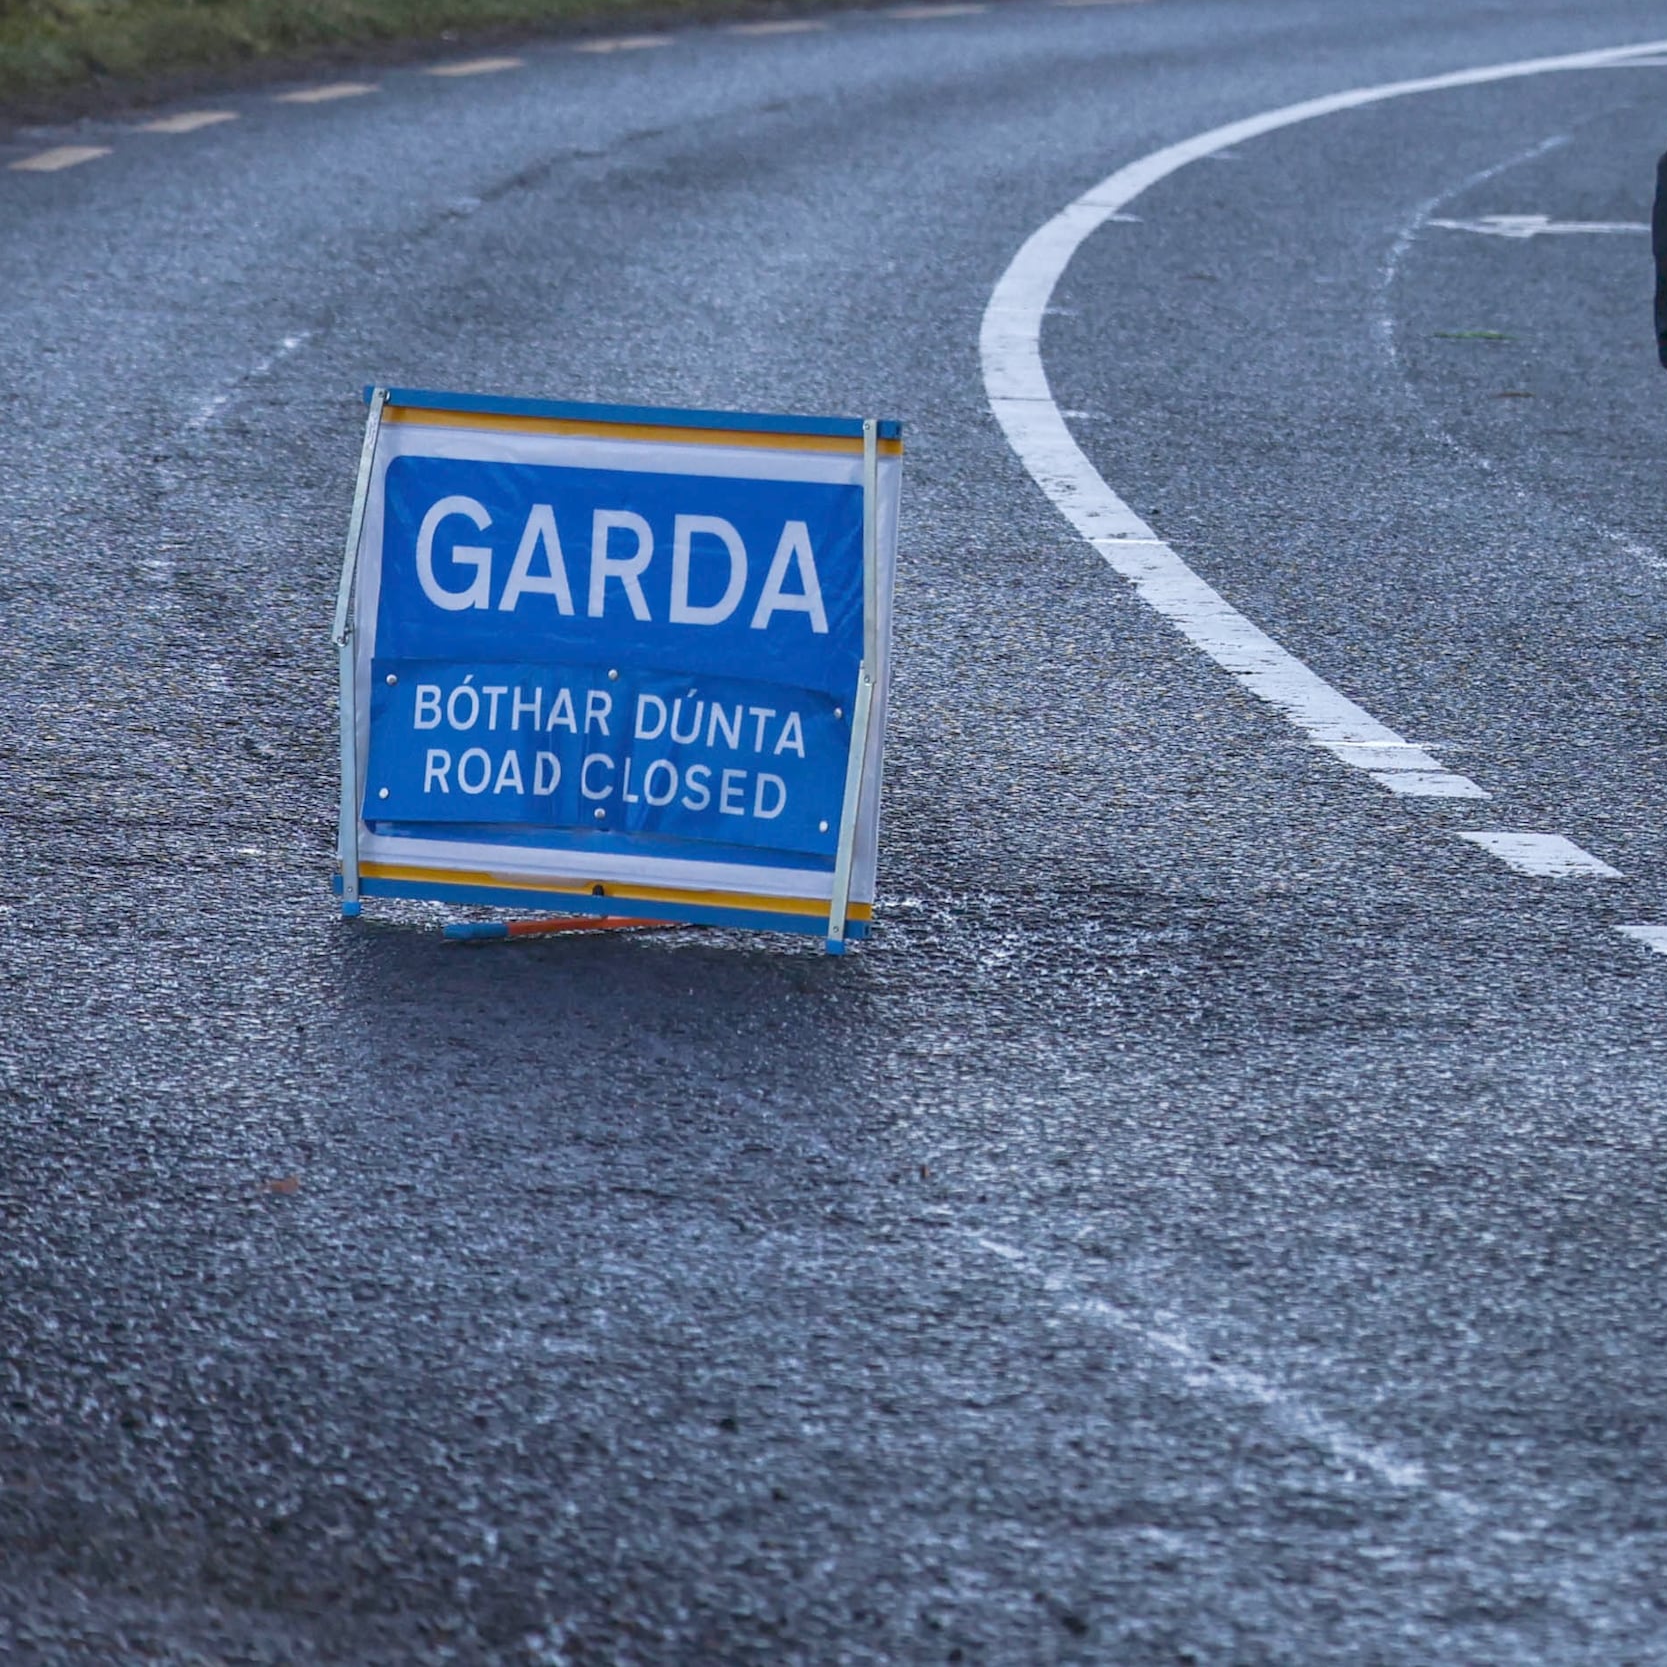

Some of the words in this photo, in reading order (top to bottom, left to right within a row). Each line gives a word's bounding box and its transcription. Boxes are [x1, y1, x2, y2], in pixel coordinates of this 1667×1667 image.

[415, 495, 829, 634] GARDA
[413, 674, 612, 736] BÓTHAR
[634, 687, 806, 759] DÚNTA
[423, 747, 562, 796] ROAD
[580, 752, 788, 821] CLOSED
